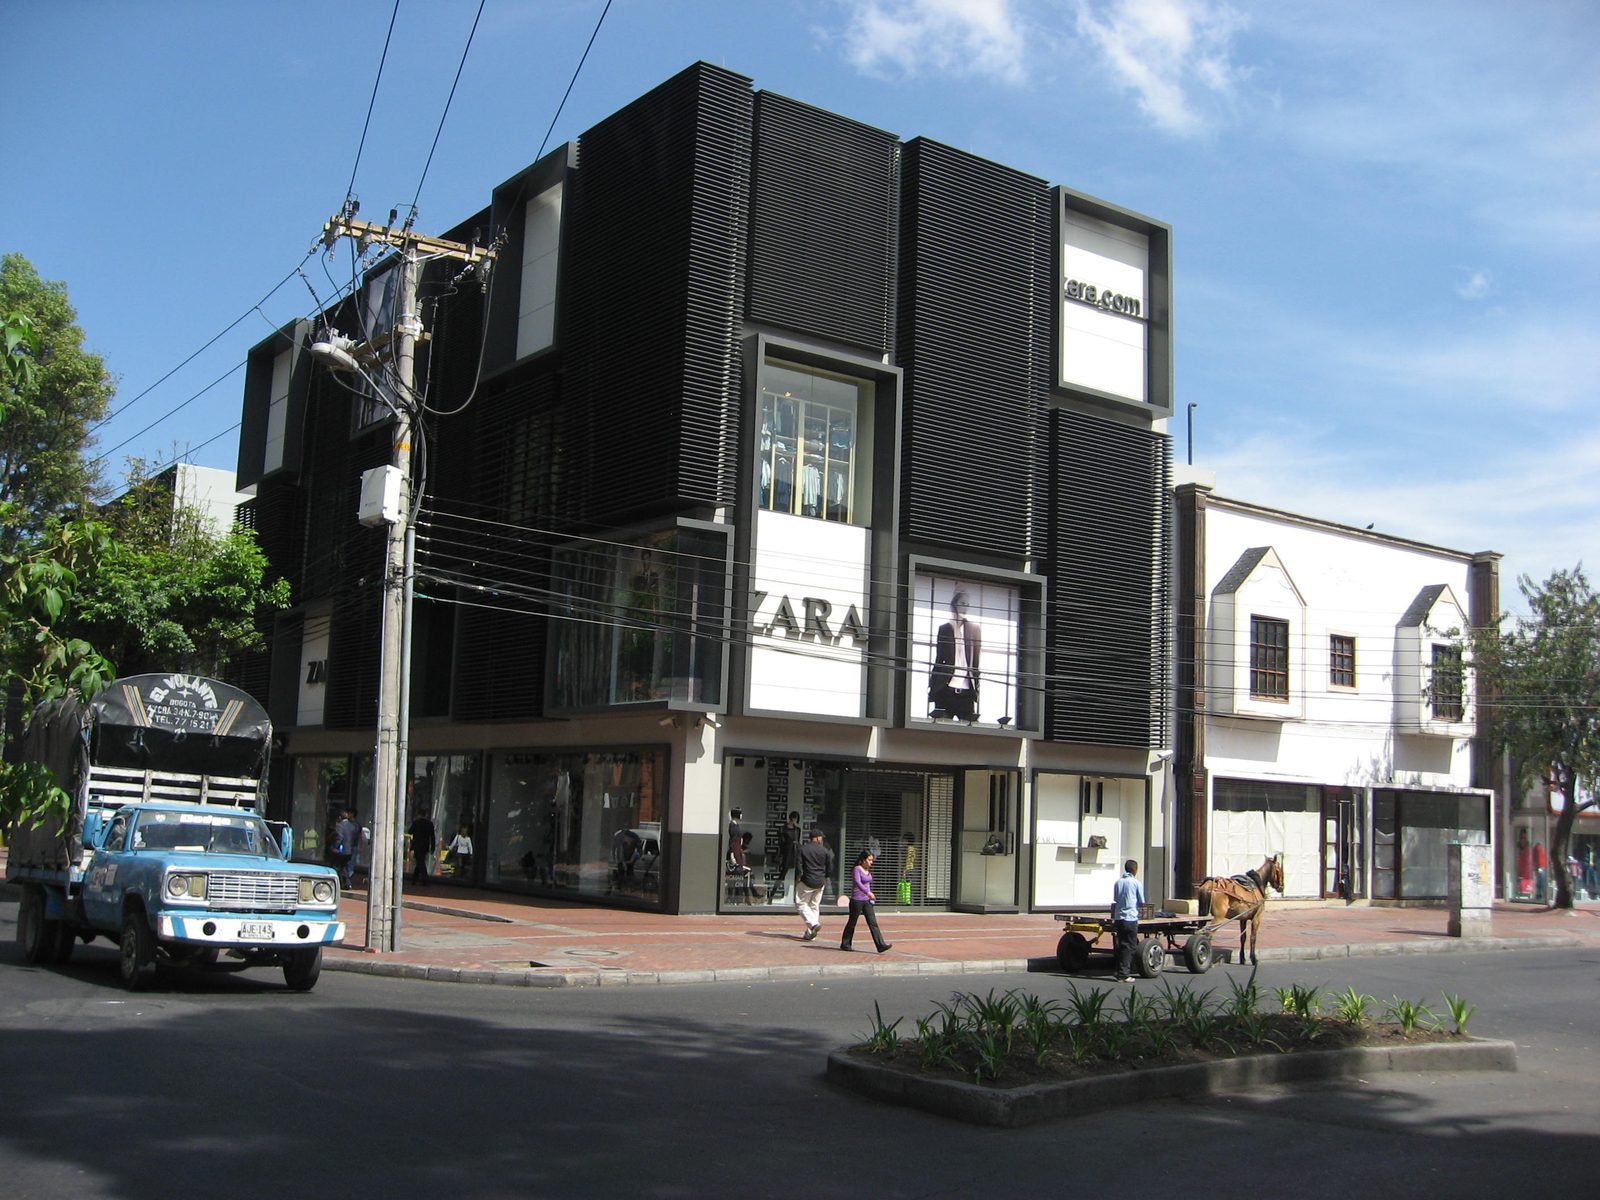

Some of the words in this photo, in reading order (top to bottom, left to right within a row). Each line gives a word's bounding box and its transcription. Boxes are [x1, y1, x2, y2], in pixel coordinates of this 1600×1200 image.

[748, 590, 868, 643] ZARA
[149, 686, 170, 703] EL
[163, 674, 218, 709] VOLANTE
[169, 698, 197, 708] BOGOTA
